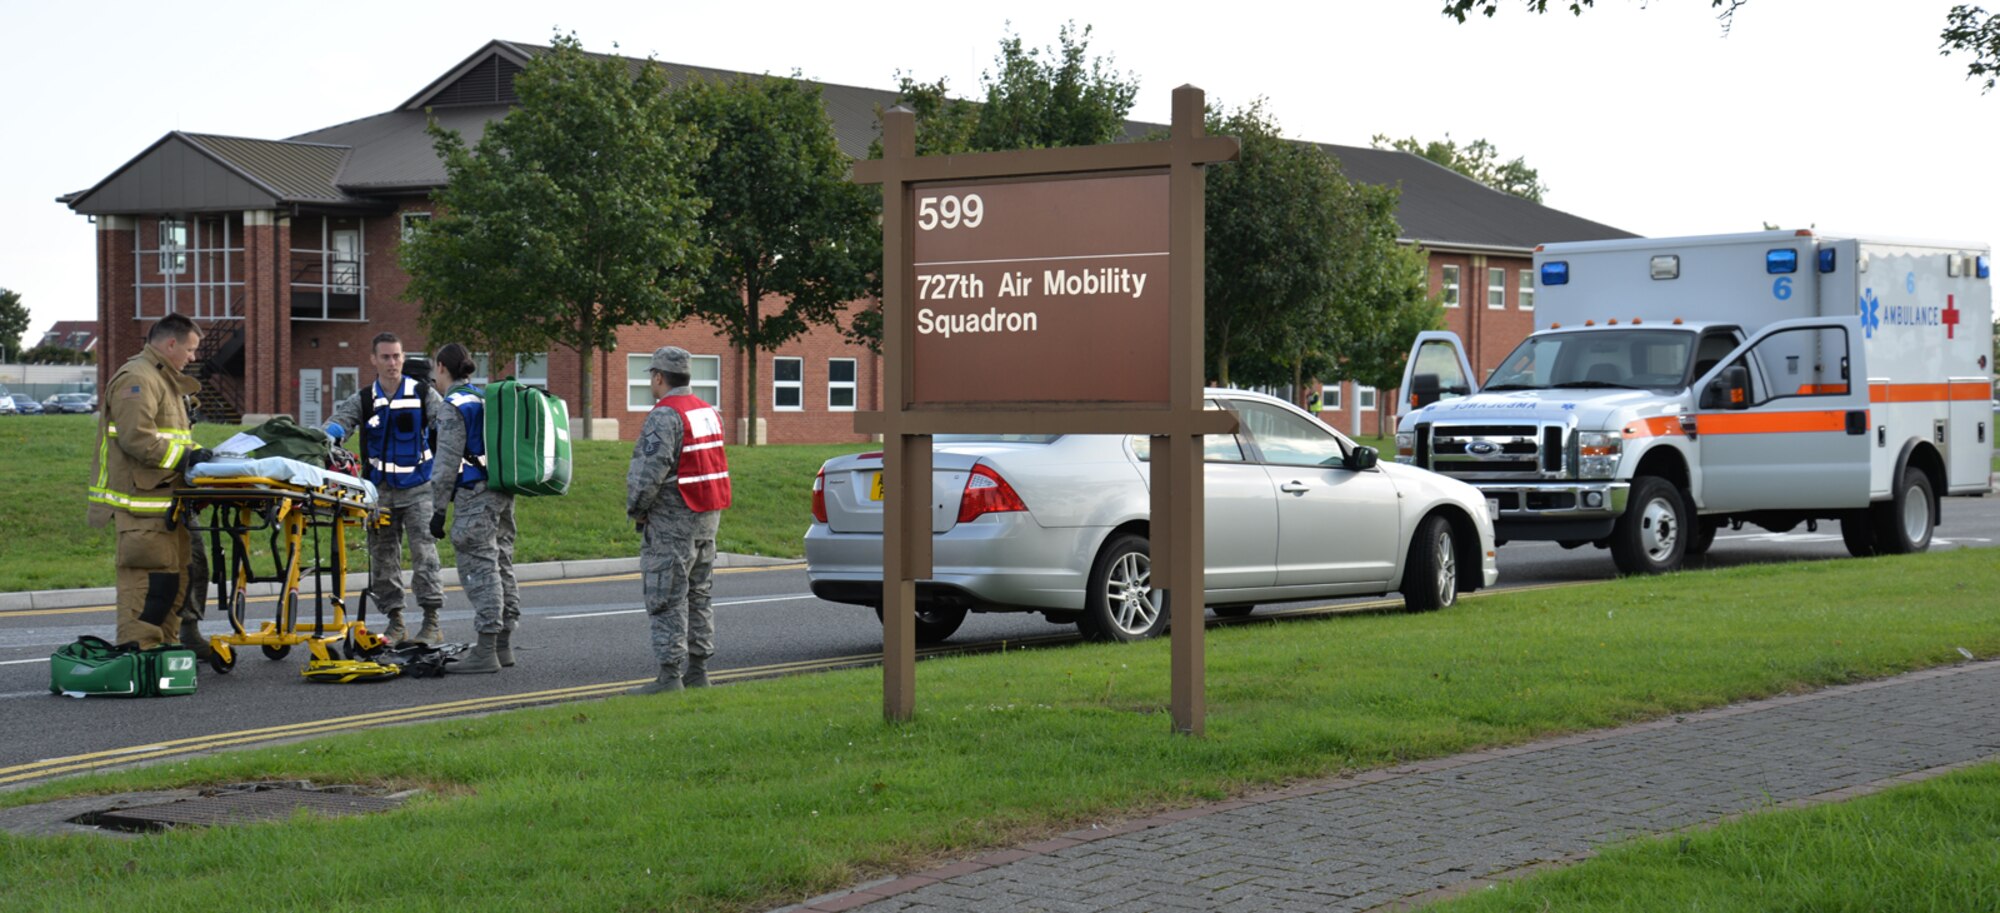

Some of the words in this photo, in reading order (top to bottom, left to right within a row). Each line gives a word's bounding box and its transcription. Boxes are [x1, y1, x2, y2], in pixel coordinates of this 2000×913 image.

[918, 194, 984, 230] 599
[917, 273, 984, 300] 727th
[998, 272, 1032, 298] Air
[1043, 267, 1147, 298] Mobility
[1773, 276, 1793, 300] 6
[1906, 271, 1916, 295] 6
[917, 307, 1037, 339] Squadron
[1883, 305, 1938, 326] AMBULANCE
